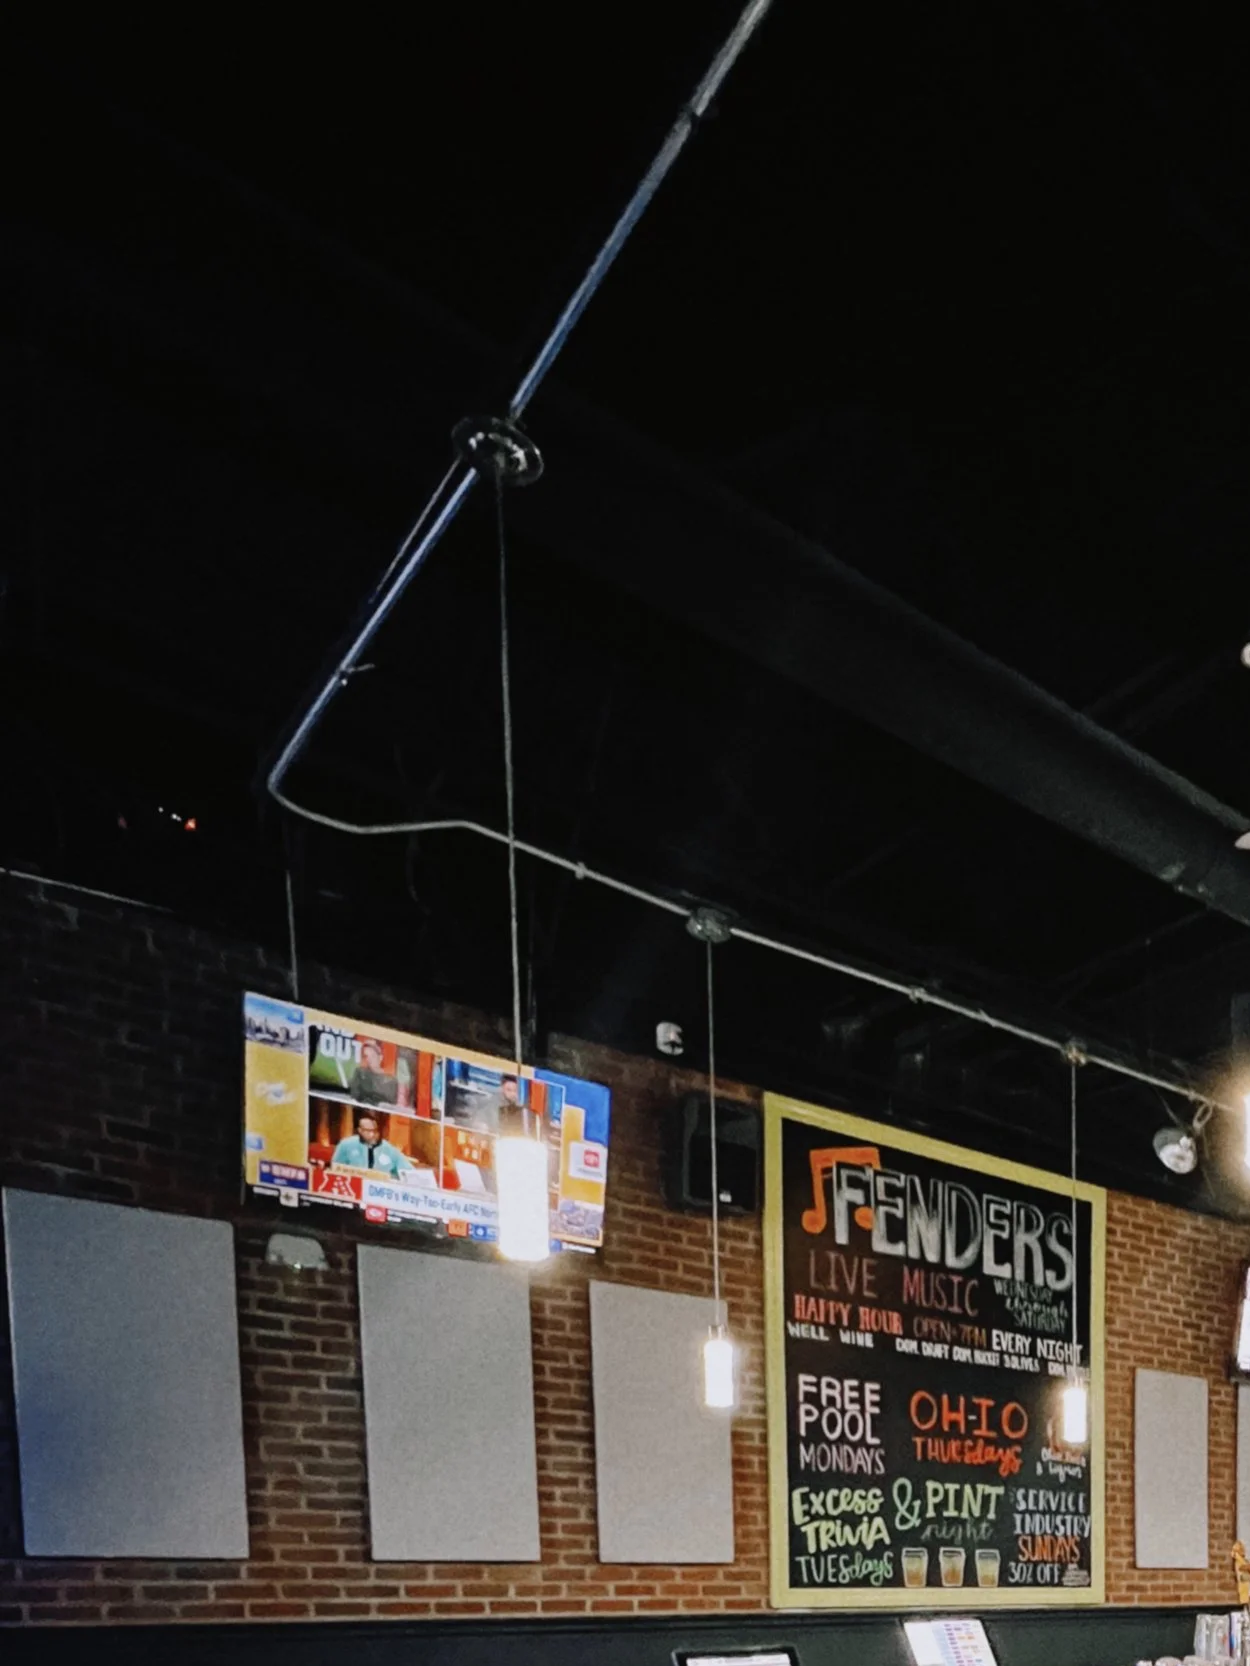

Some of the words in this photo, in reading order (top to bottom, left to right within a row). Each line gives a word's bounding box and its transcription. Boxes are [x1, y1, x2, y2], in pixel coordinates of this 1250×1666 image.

[320, 1032, 364, 1064] OUT
[832, 1159, 1075, 1289] FENDERS
[808, 1250, 879, 1299] LIVE
[902, 1264, 980, 1317] MUSIC
[786, 1320, 830, 1342] WELL
[838, 1328, 875, 1349] WINE
[857, 1306, 904, 1336] HOUR
[991, 1328, 1032, 1356] EVERY
[1036, 1336, 1083, 1365] NIGHT
[797, 1372, 881, 1415] FREE
[798, 1402, 881, 1446] POOL
[909, 1389, 1029, 1440] OH-IO
[799, 1441, 886, 1476] MONDAYS
[891, 1476, 922, 1531] &
[925, 1480, 1005, 1520] PINT
[1014, 1487, 1087, 1513] SERVICE
[920, 1518, 994, 1545] night
[1013, 1513, 1092, 1539] INDUSTRY
[1017, 1535, 1081, 1563] SUNDAYS
[1036, 1563, 1061, 1584] OFF
